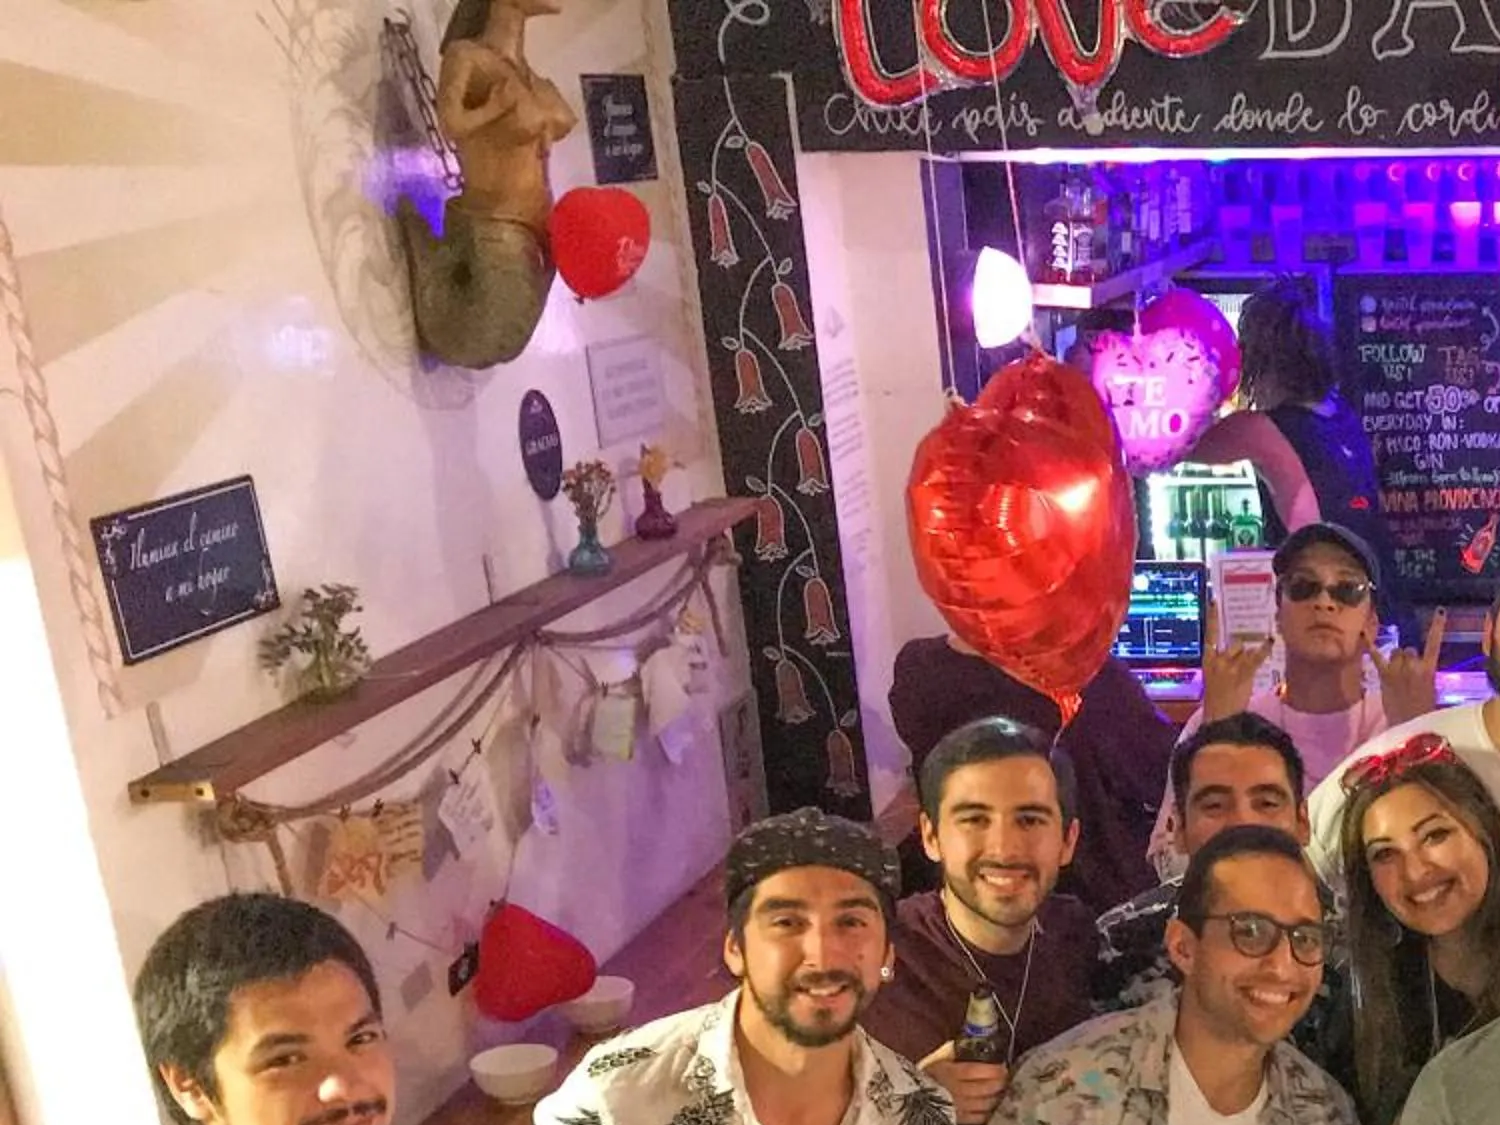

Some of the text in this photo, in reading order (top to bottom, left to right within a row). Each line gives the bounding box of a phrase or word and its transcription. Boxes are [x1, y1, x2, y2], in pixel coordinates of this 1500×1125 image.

[1057, 89, 1200, 135] adiente
[1214, 91, 1323, 132] donde
[1338, 86, 1386, 135] lo
[1358, 344, 1427, 363] FOLLOW
[1395, 390, 1424, 409] GET
[1362, 413, 1433, 432] EVERYDAY
